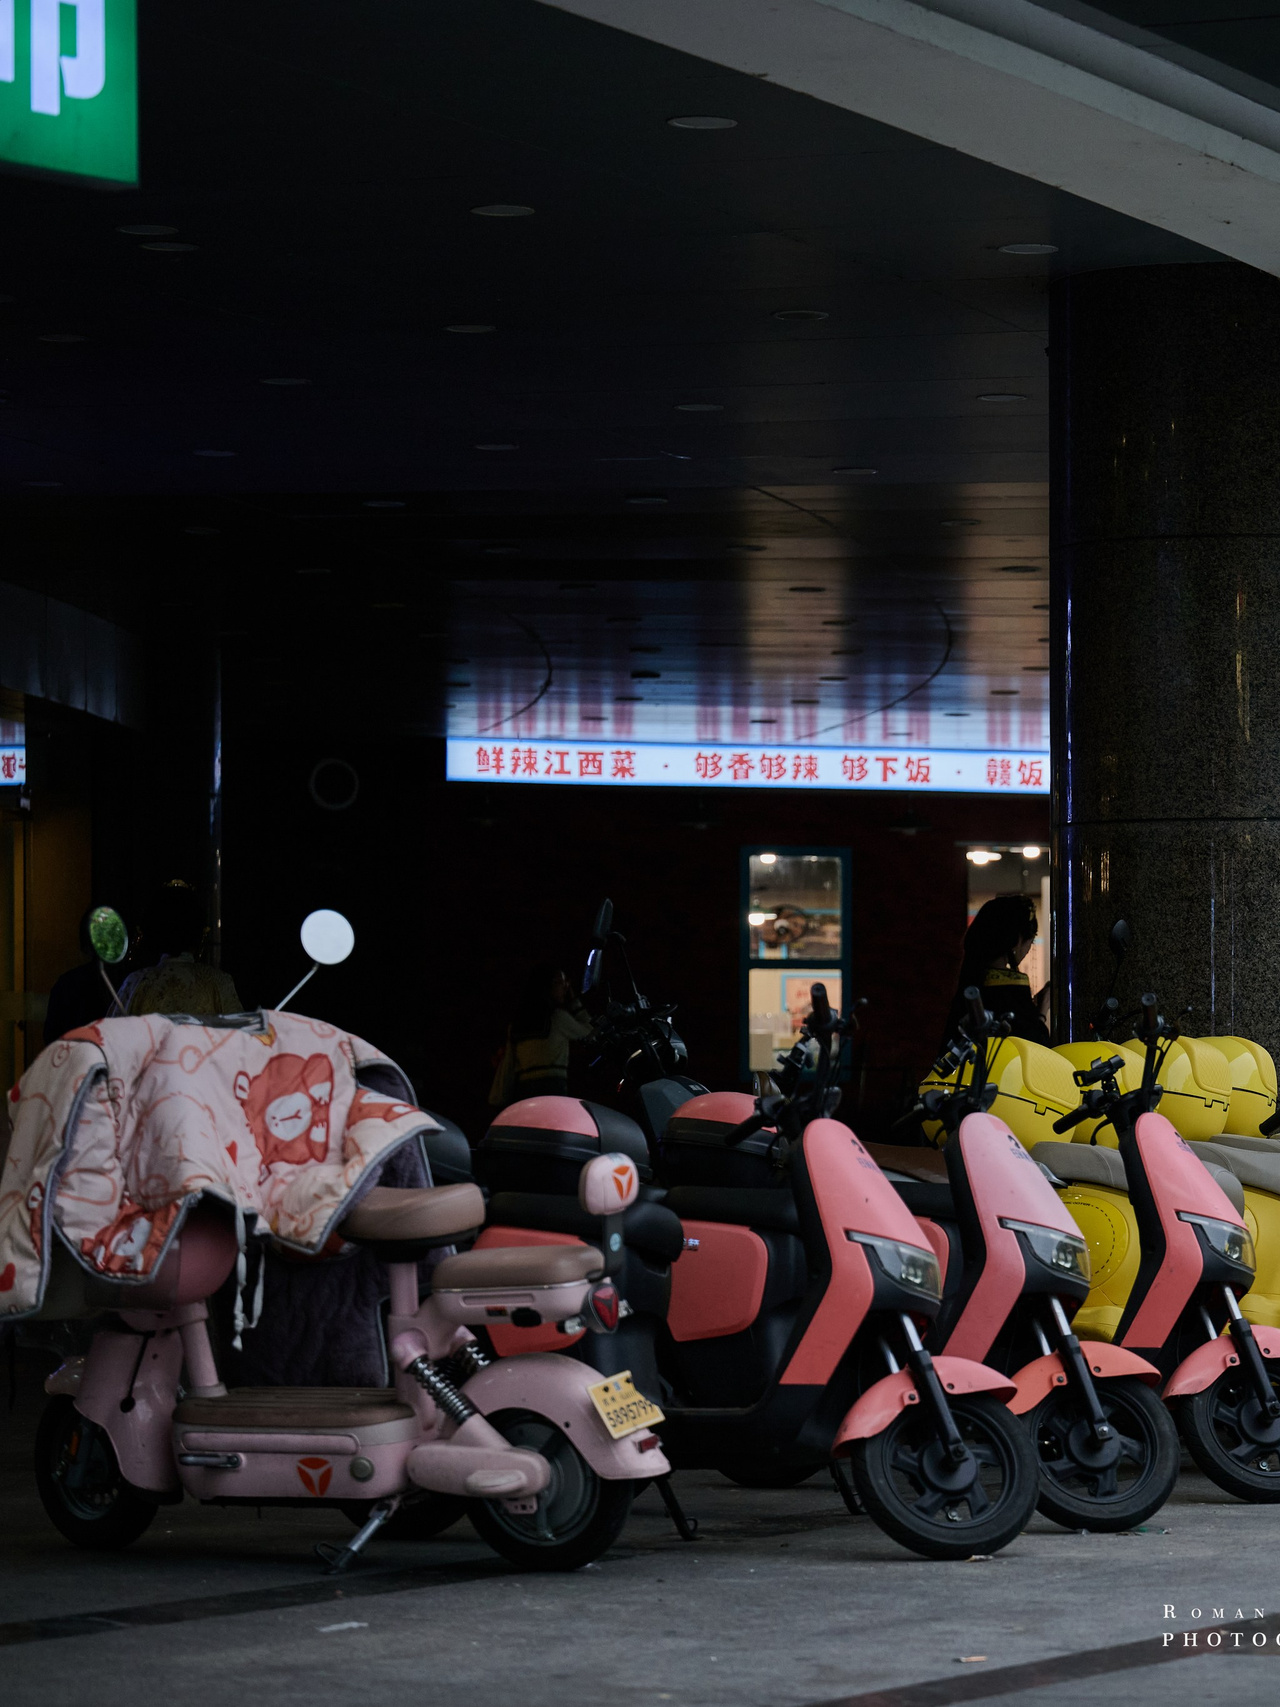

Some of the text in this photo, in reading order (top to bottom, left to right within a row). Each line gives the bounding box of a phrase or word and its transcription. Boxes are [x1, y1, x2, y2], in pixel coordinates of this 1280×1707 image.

[476, 746, 636, 778] 鲜辣江西菜
[694, 752, 819, 781] 够香够辣
[841, 754, 931, 783] 够下饭
